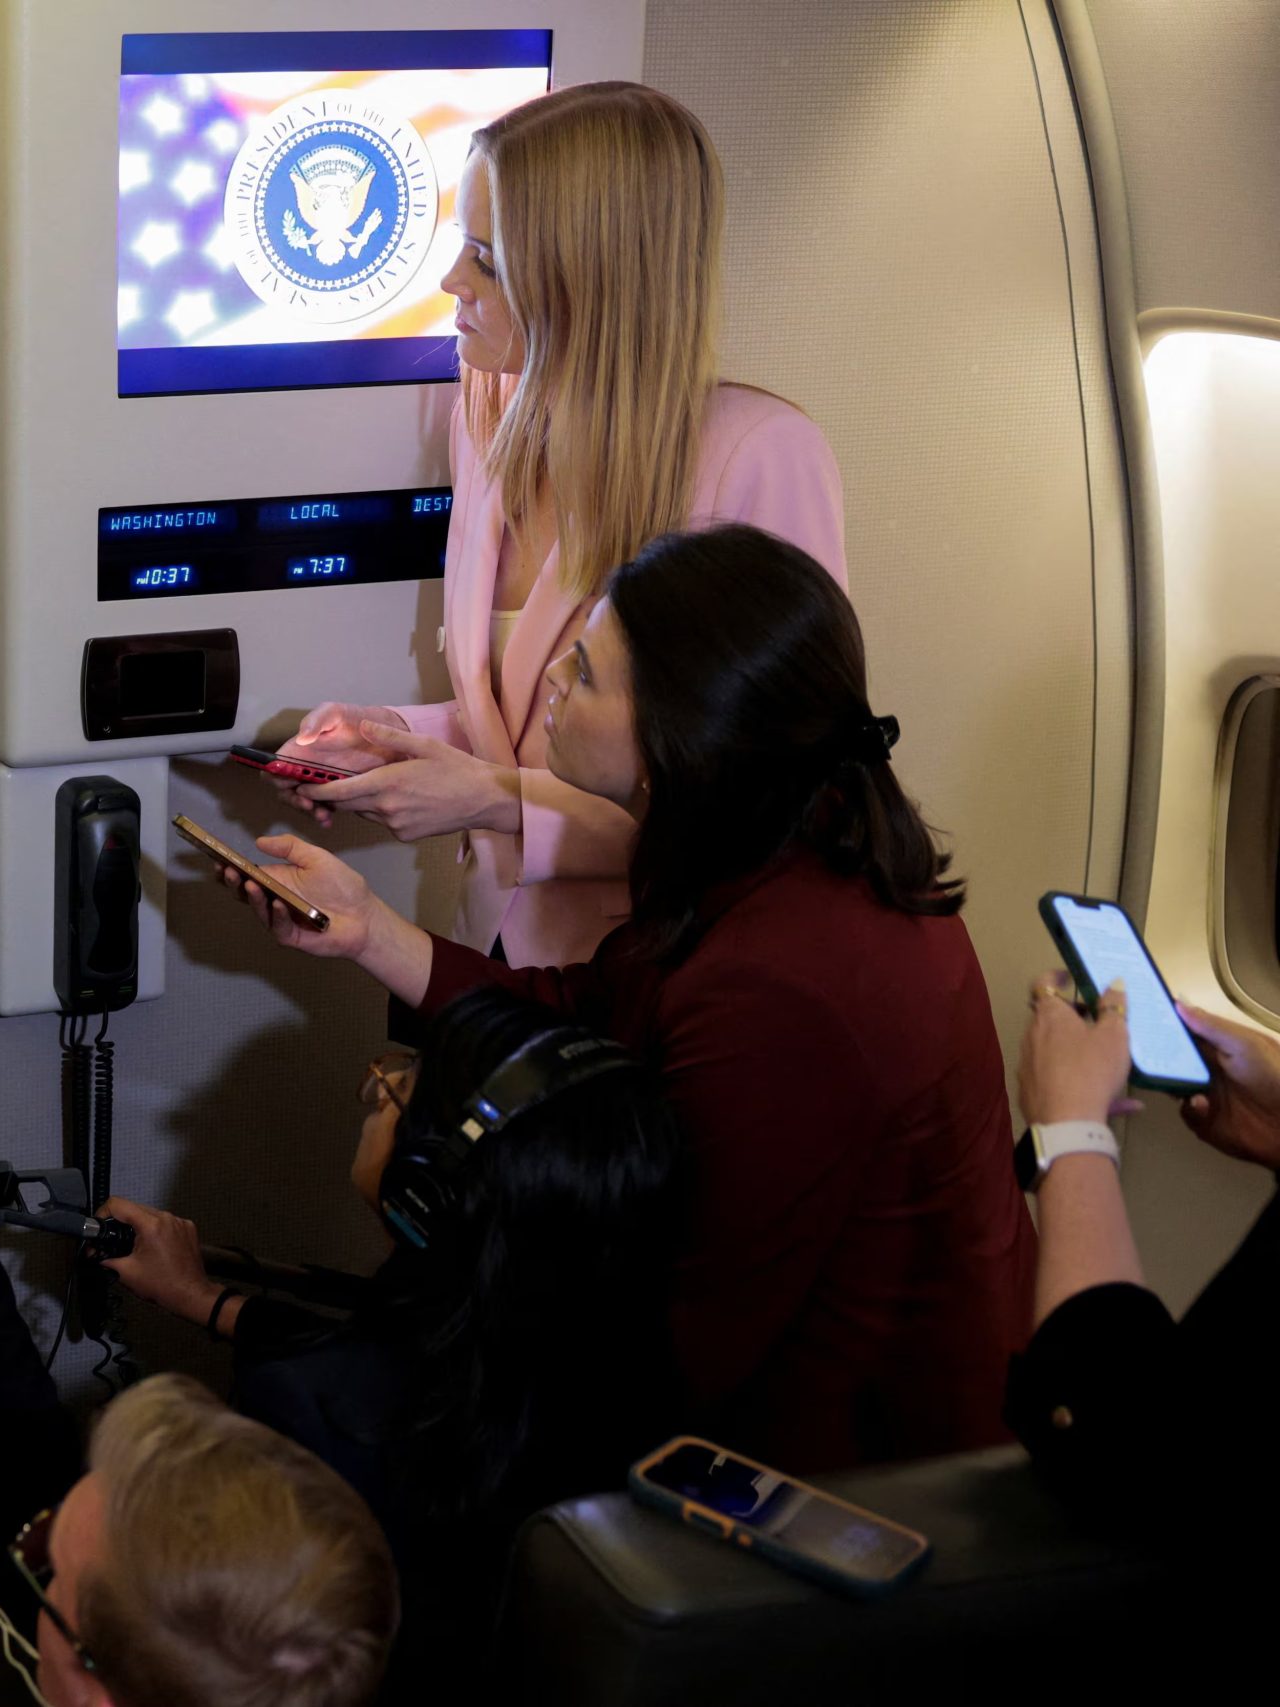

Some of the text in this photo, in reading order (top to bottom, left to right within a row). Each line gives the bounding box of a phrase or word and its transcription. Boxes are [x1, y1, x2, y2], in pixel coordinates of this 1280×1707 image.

[236, 100, 327, 202] PRESIDENT
[290, 504, 340, 520] LOCAL
[413, 496, 453, 513] DEST
[111, 511, 217, 531] WASHINGTON
[293, 557, 346, 575] PM 7:37
[145, 567, 190, 585] 10:37
